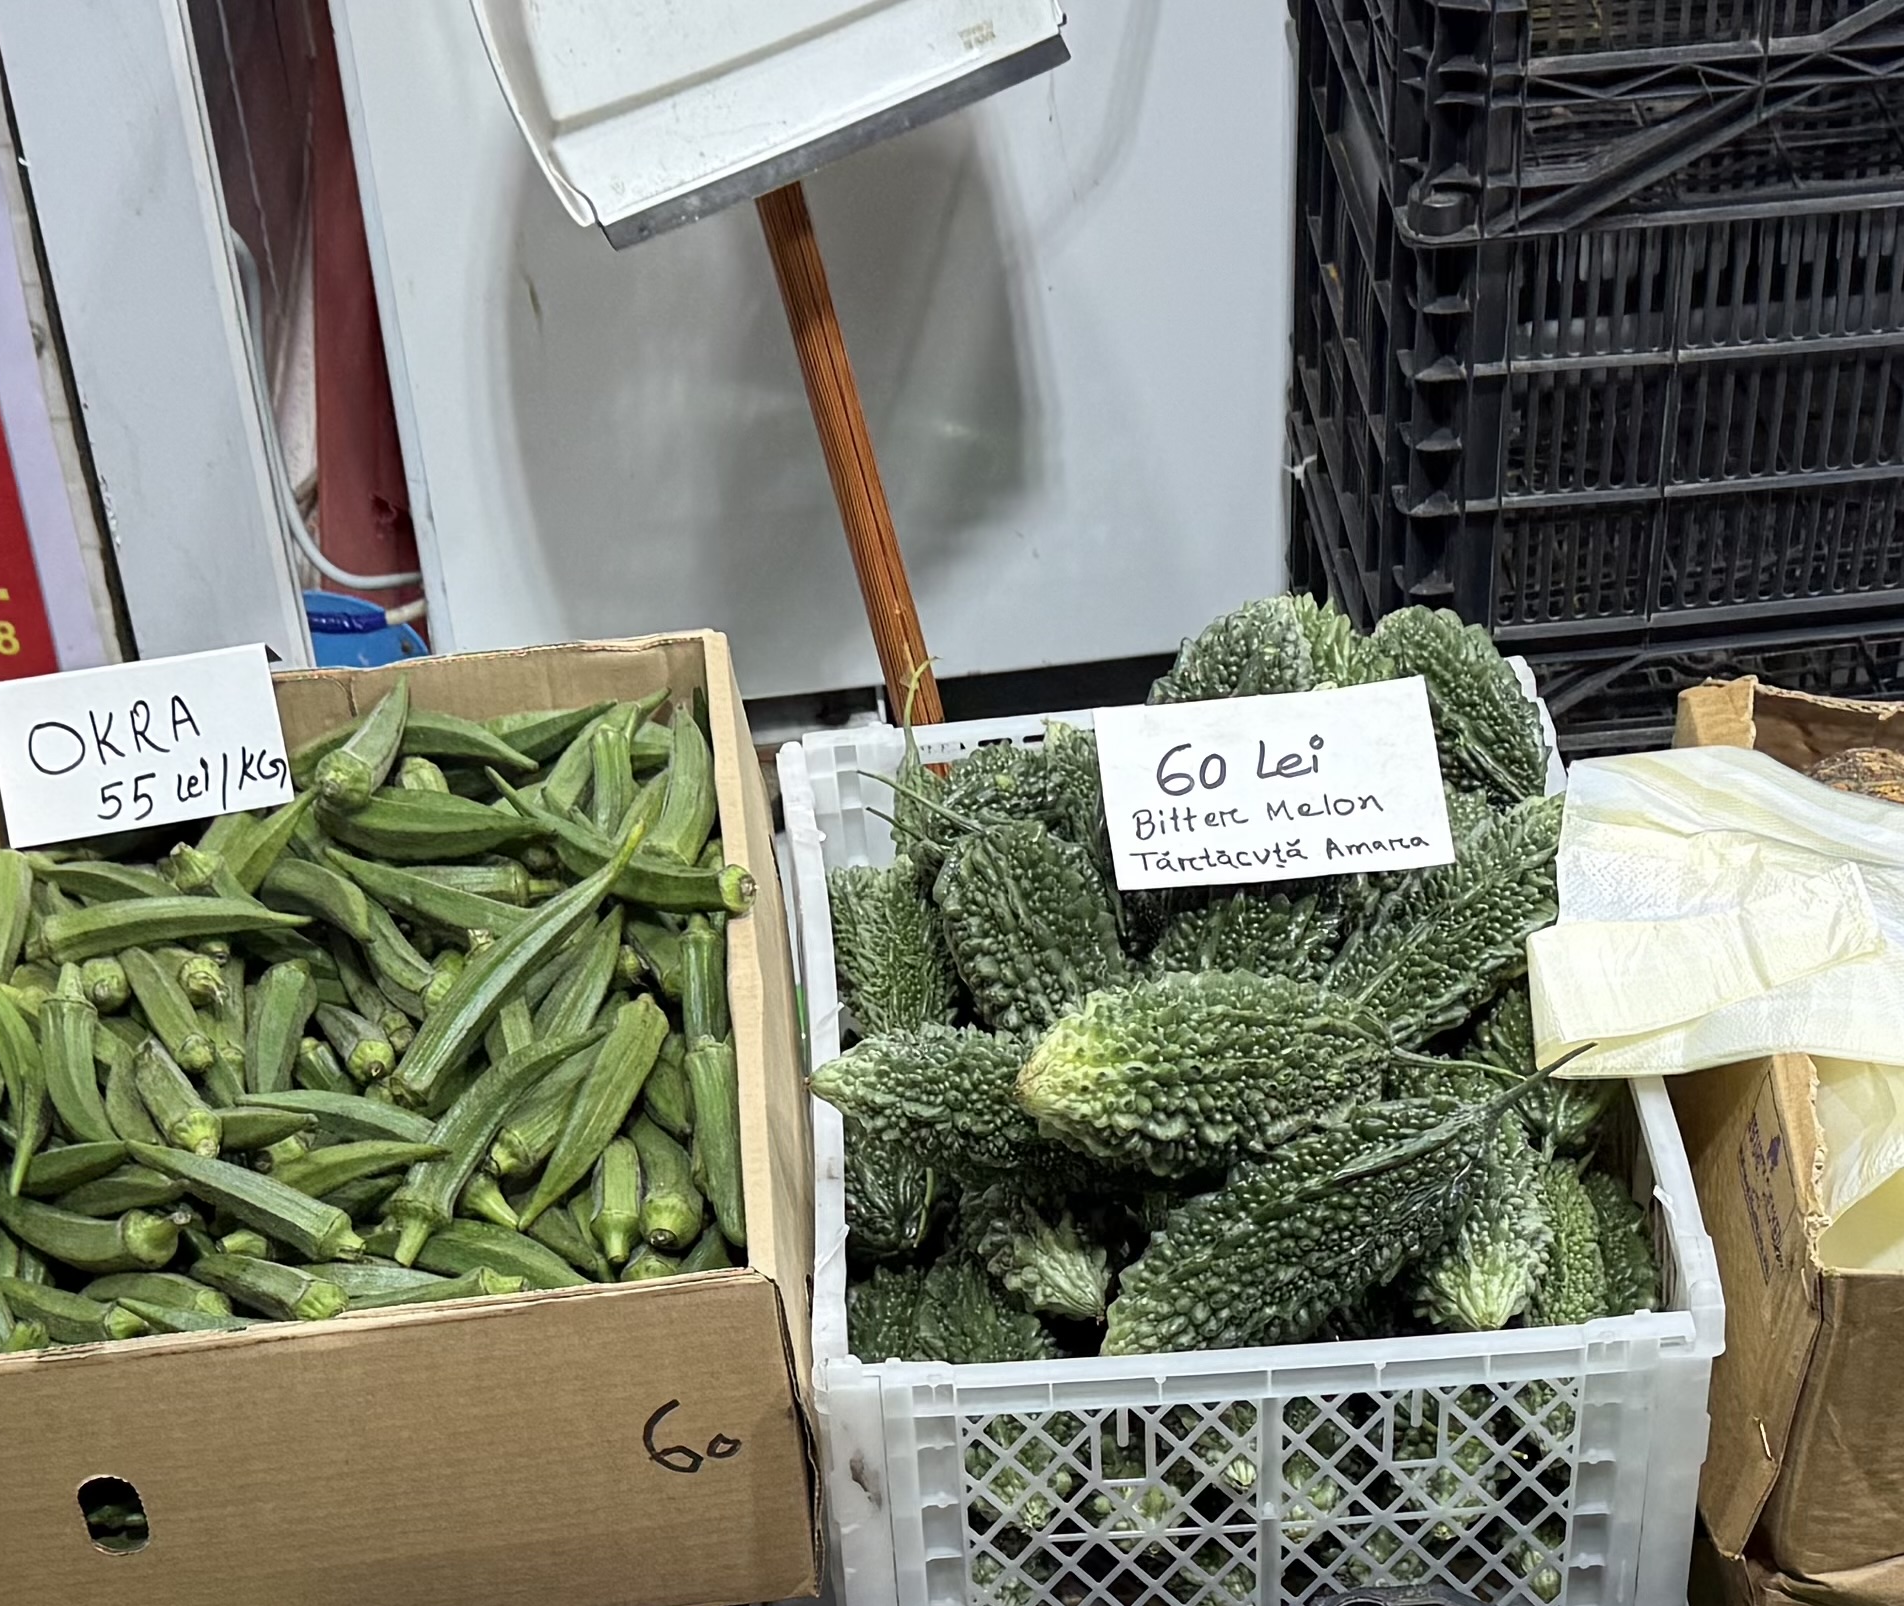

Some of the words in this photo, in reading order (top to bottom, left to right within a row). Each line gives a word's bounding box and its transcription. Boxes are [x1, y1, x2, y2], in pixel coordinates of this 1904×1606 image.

[28, 694, 200, 776] OKRA
[1155, 742, 1227, 797] 60
[97, 772, 157, 821] 55
[1132, 808, 1249, 841] Bitter
[1266, 793, 1384, 821] Melon
[1326, 835, 1431, 861] Amara
